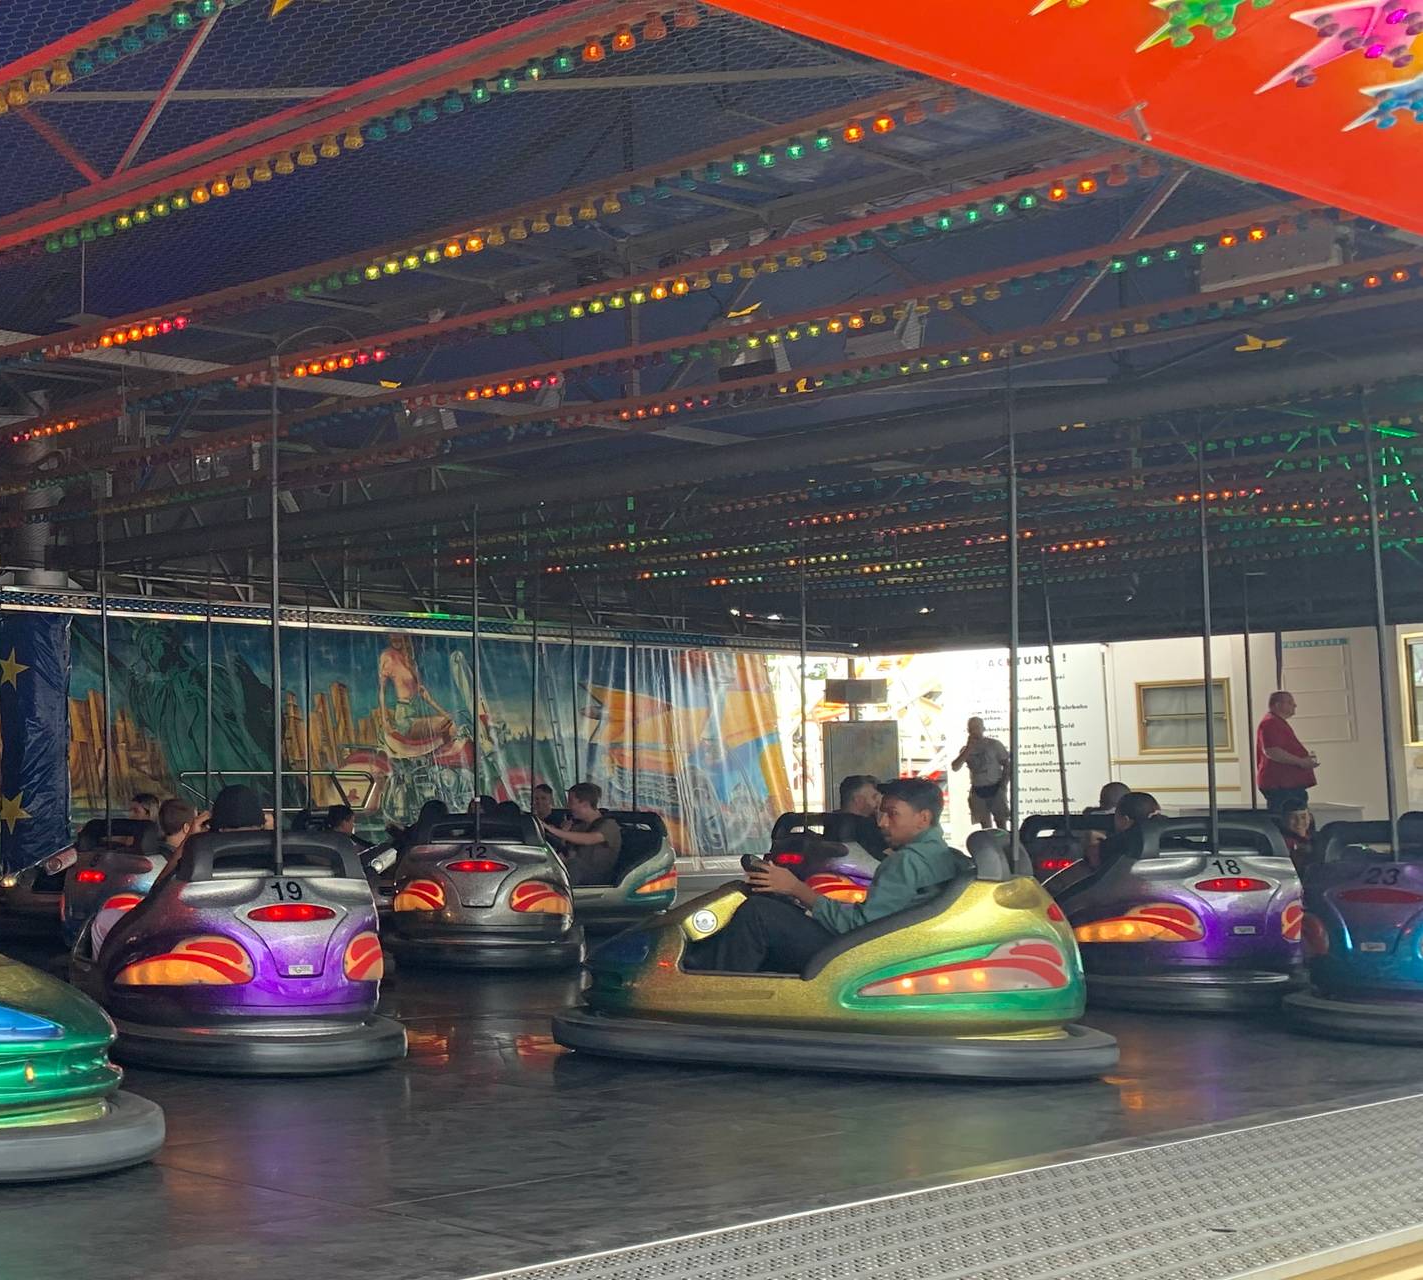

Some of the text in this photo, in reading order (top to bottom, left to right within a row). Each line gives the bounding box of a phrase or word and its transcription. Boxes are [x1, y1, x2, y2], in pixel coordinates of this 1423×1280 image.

[988, 654, 1052, 667] ACTUNG
[465, 846, 487, 859] 12
[1212, 859, 1241, 876] 18
[1365, 867, 1401, 886] 23
[270, 881, 303, 901] 19
